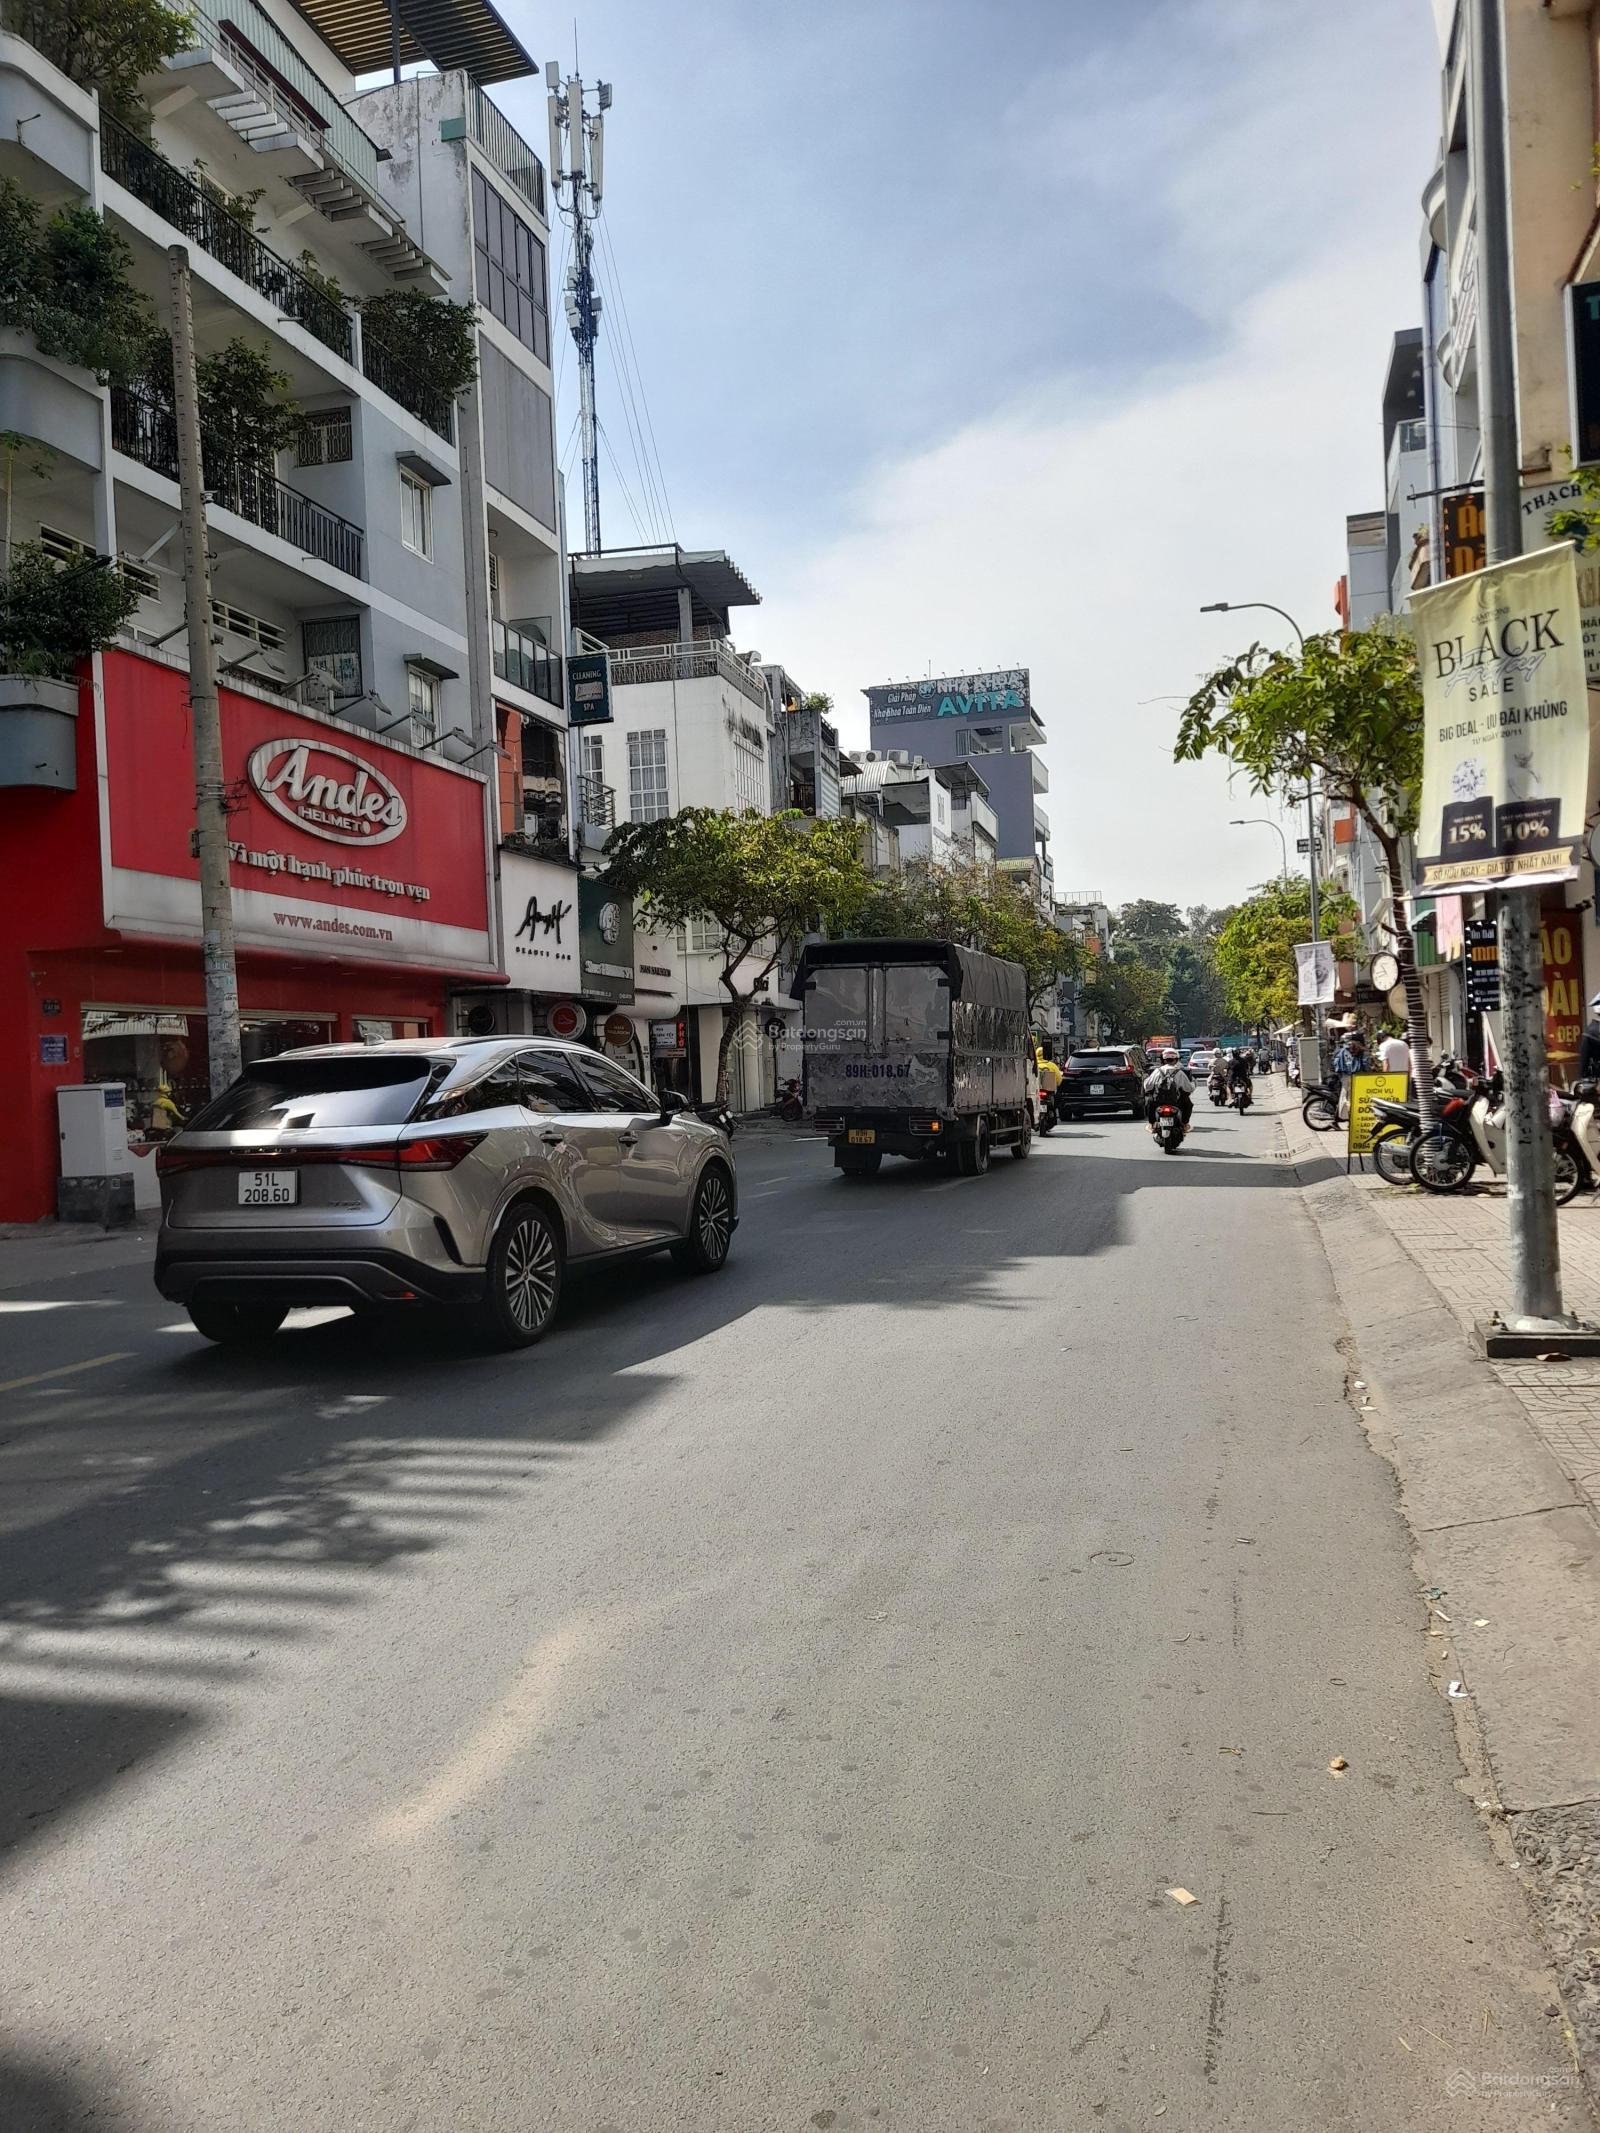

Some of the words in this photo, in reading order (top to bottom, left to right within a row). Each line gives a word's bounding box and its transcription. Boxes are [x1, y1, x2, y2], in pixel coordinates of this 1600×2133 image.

[1522, 484, 1583, 515] THẠCH
[1432, 608, 1565, 679] BLACK
[572, 670, 602, 681] CLEANING
[1468, 677, 1514, 702] SALE
[583, 703, 595, 711] SPA
[1439, 726, 1454, 743] BIG
[1456, 719, 1479, 739] DEAL
[1499, 707, 1520, 726] ĐÃI
[1523, 699, 1568, 723] KHỦNG
[259, 744, 403, 827] Andes
[298, 805, 362, 833] HELMET
[1502, 819, 1550, 842] 10%
[1448, 822, 1487, 845] 15%
[249, 849, 287, 876] một
[287, 854, 333, 882] hạnh
[332, 865, 372, 888] phúc
[371, 873, 406, 898] trọn
[406, 883, 431, 903] vẹn
[1459, 864, 1481, 879] NGAY
[273, 912, 393, 941] www.andes.com.vn
[254, 1172, 279, 1187] 51L
[244, 1188, 290, 1203] 208.60
